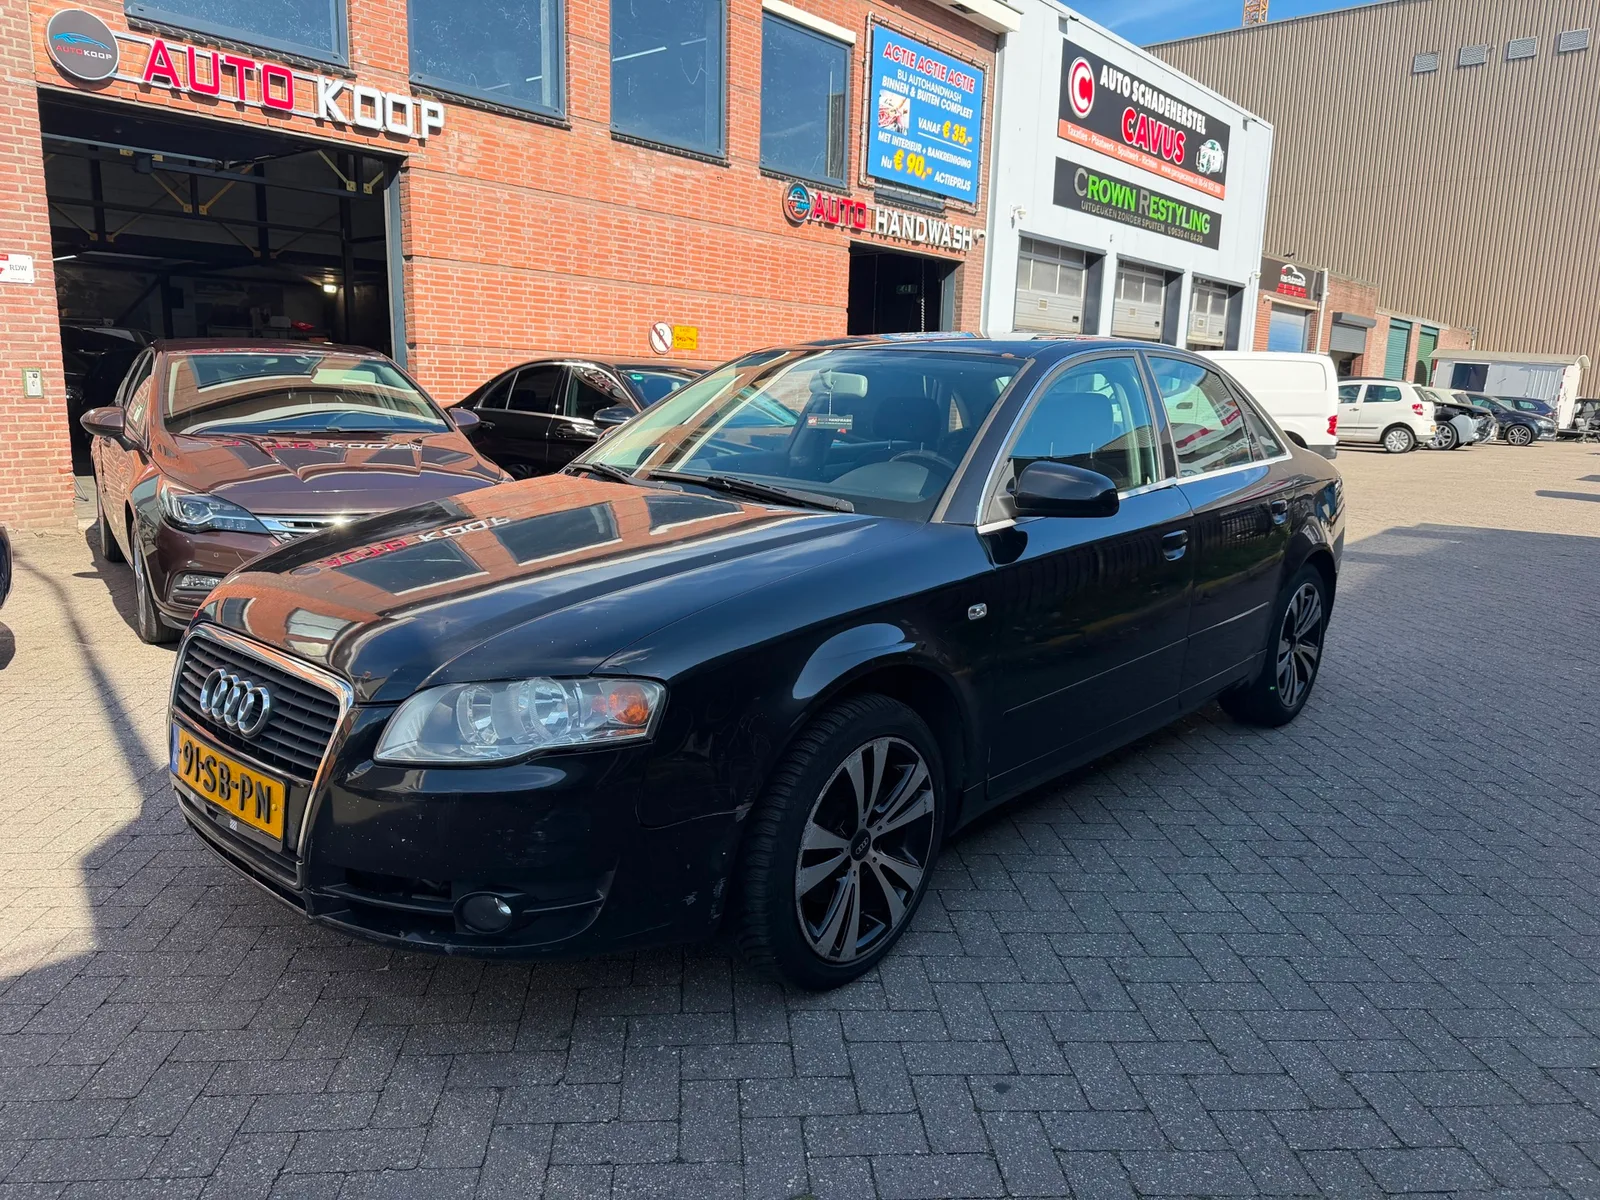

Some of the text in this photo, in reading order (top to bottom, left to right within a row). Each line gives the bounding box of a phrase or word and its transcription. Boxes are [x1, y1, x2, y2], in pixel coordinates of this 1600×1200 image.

[142, 38, 445, 140] AUTO KOOP
[883, 41, 976, 94] ACTIE ACTIE ACTIE
[897, 69, 962, 103] BIJ AUTOHANDWASH
[882, 75, 974, 120] BINNEN & BUITEN COMPLEET
[1100, 64, 1206, 135] AUTO SCHADEHERSTEL
[877, 131, 892, 144] MET
[892, 135, 922, 154] INTERIEUR
[927, 146, 972, 169] BANKREINIGING
[918, 117, 941, 134] VANAF
[1121, 106, 1187, 165] CAVUS
[934, 171, 972, 191] ACTIEPRIJS
[1074, 167, 1211, 235] CROWN RESTYLING
[812, 191, 973, 251] AUTO HANDWASH
[1081, 200, 1117, 221] UITDEUKEN
[1117, 211, 1142, 225] ZONDER
[1142, 218, 1165, 233] SPUITEN
[182, 740, 272, 824] 91-SB-PN
